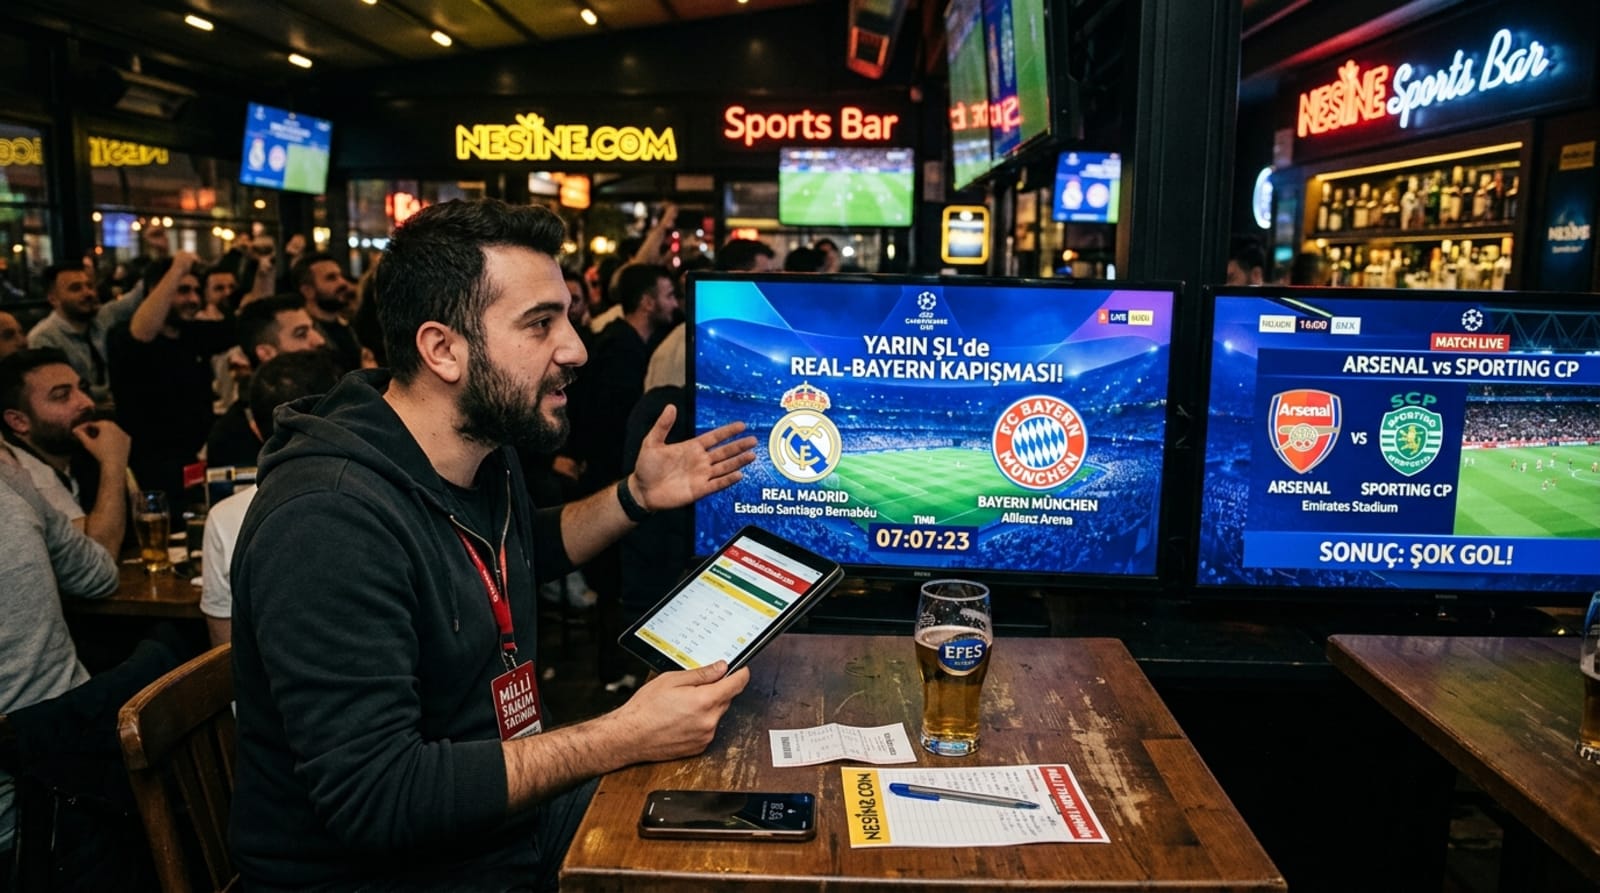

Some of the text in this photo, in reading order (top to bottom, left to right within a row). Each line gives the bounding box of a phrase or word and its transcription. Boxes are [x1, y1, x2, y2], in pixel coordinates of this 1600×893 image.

[1388, 50, 1476, 128] Sports
[1479, 29, 1549, 92] Bar
[724, 106, 898, 146] Sports Bar
[863, 336, 990, 361] YARIN ŞL'de
[1435, 336, 1504, 349] MATCH LIVE
[791, 356, 1064, 386] REAL-BAYERN KAPIŞMASI!
[1342, 355, 1579, 378] ARSENAL vs SPORTING CP
[1390, 391, 1437, 409] SCP
[1278, 402, 1331, 417] Arsenal
[999, 399, 1082, 437] FC BAYERN
[762, 488, 849, 503] REAL MADRID
[1267, 480, 1331, 495] ARSENAL
[1361, 482, 1452, 498] SPORTING CP
[734, 502, 774, 515] Estadio
[776, 503, 823, 518] Santiago
[978, 495, 1029, 509] BAYERN
[1302, 500, 1398, 514] Emirates Stadium
[1040, 514, 1073, 526] Arena
[876, 528, 970, 551] 07:07:23
[1319, 541, 1513, 569] SONUÇ: ŞOK GOL!
[944, 644, 983, 659] EFES
